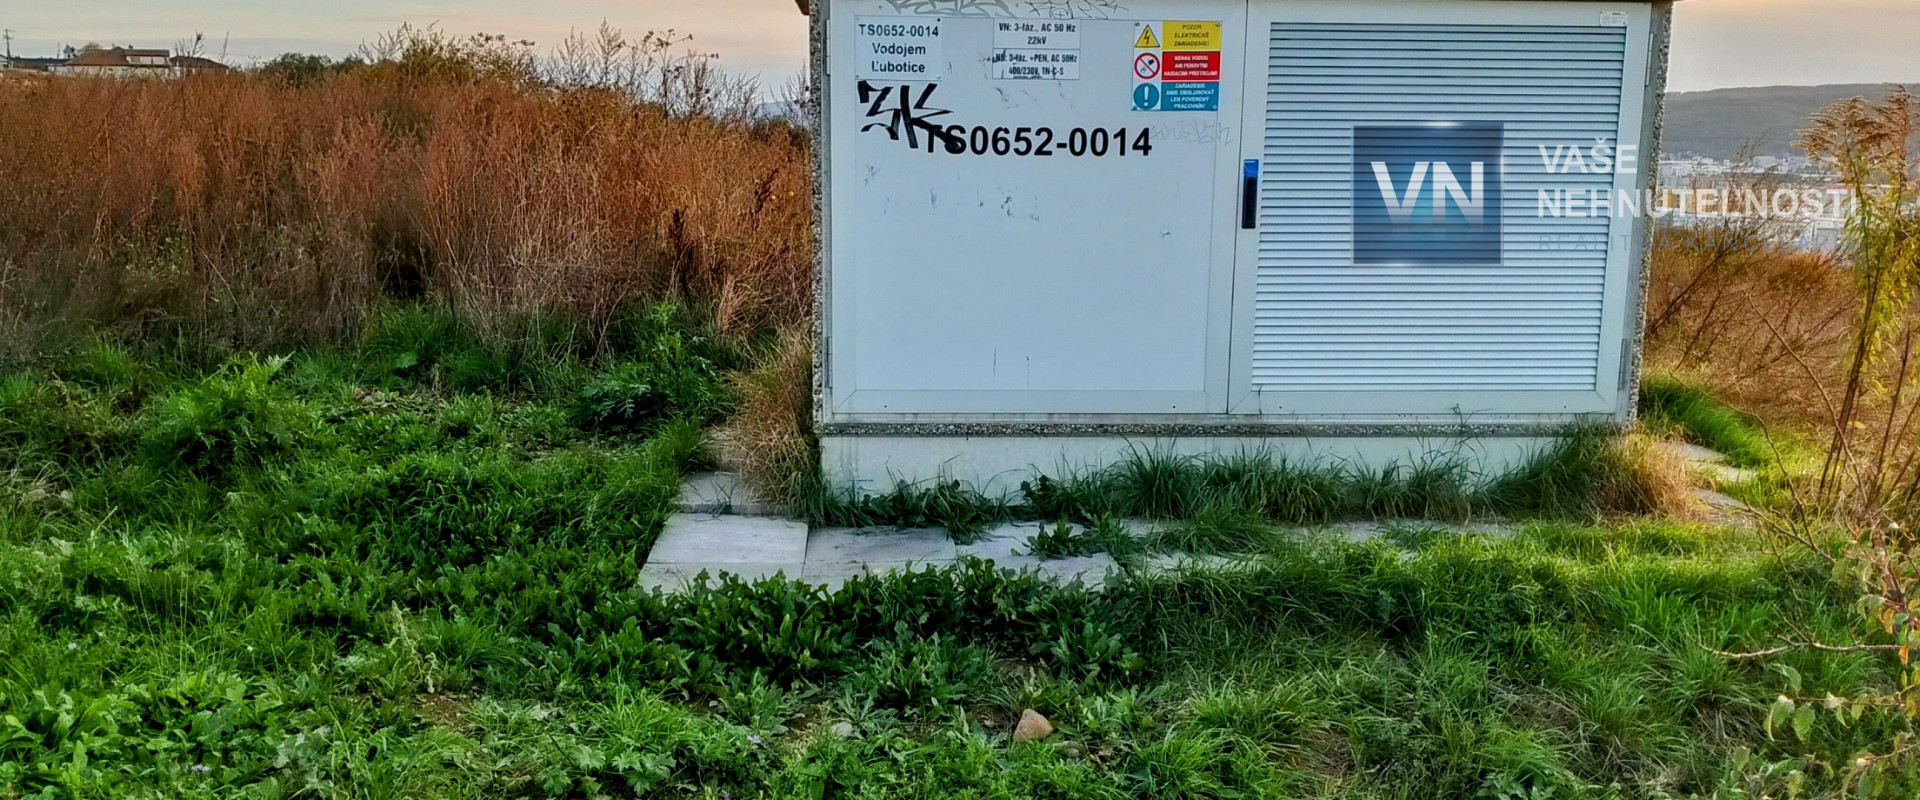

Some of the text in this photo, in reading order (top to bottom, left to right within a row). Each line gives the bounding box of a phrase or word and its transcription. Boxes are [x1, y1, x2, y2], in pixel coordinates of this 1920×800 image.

[858, 24, 939, 37] TS0652-0014
[999, 22, 1012, 32] VN:
[1041, 23, 1052, 32] AC
[1054, 23, 1064, 32] 50
[1066, 23, 1076, 32] Hz
[1027, 36, 1047, 45] 22kV
[872, 42, 926, 57] Vodojem
[1051, 54, 1060, 62] AC
[1061, 54, 1077, 63] 50Hz
[871, 60, 926, 73] Ľubotice
[1042, 66, 1064, 76] TN-C-S
[924, 124, 1152, 157] TS0652-0014
